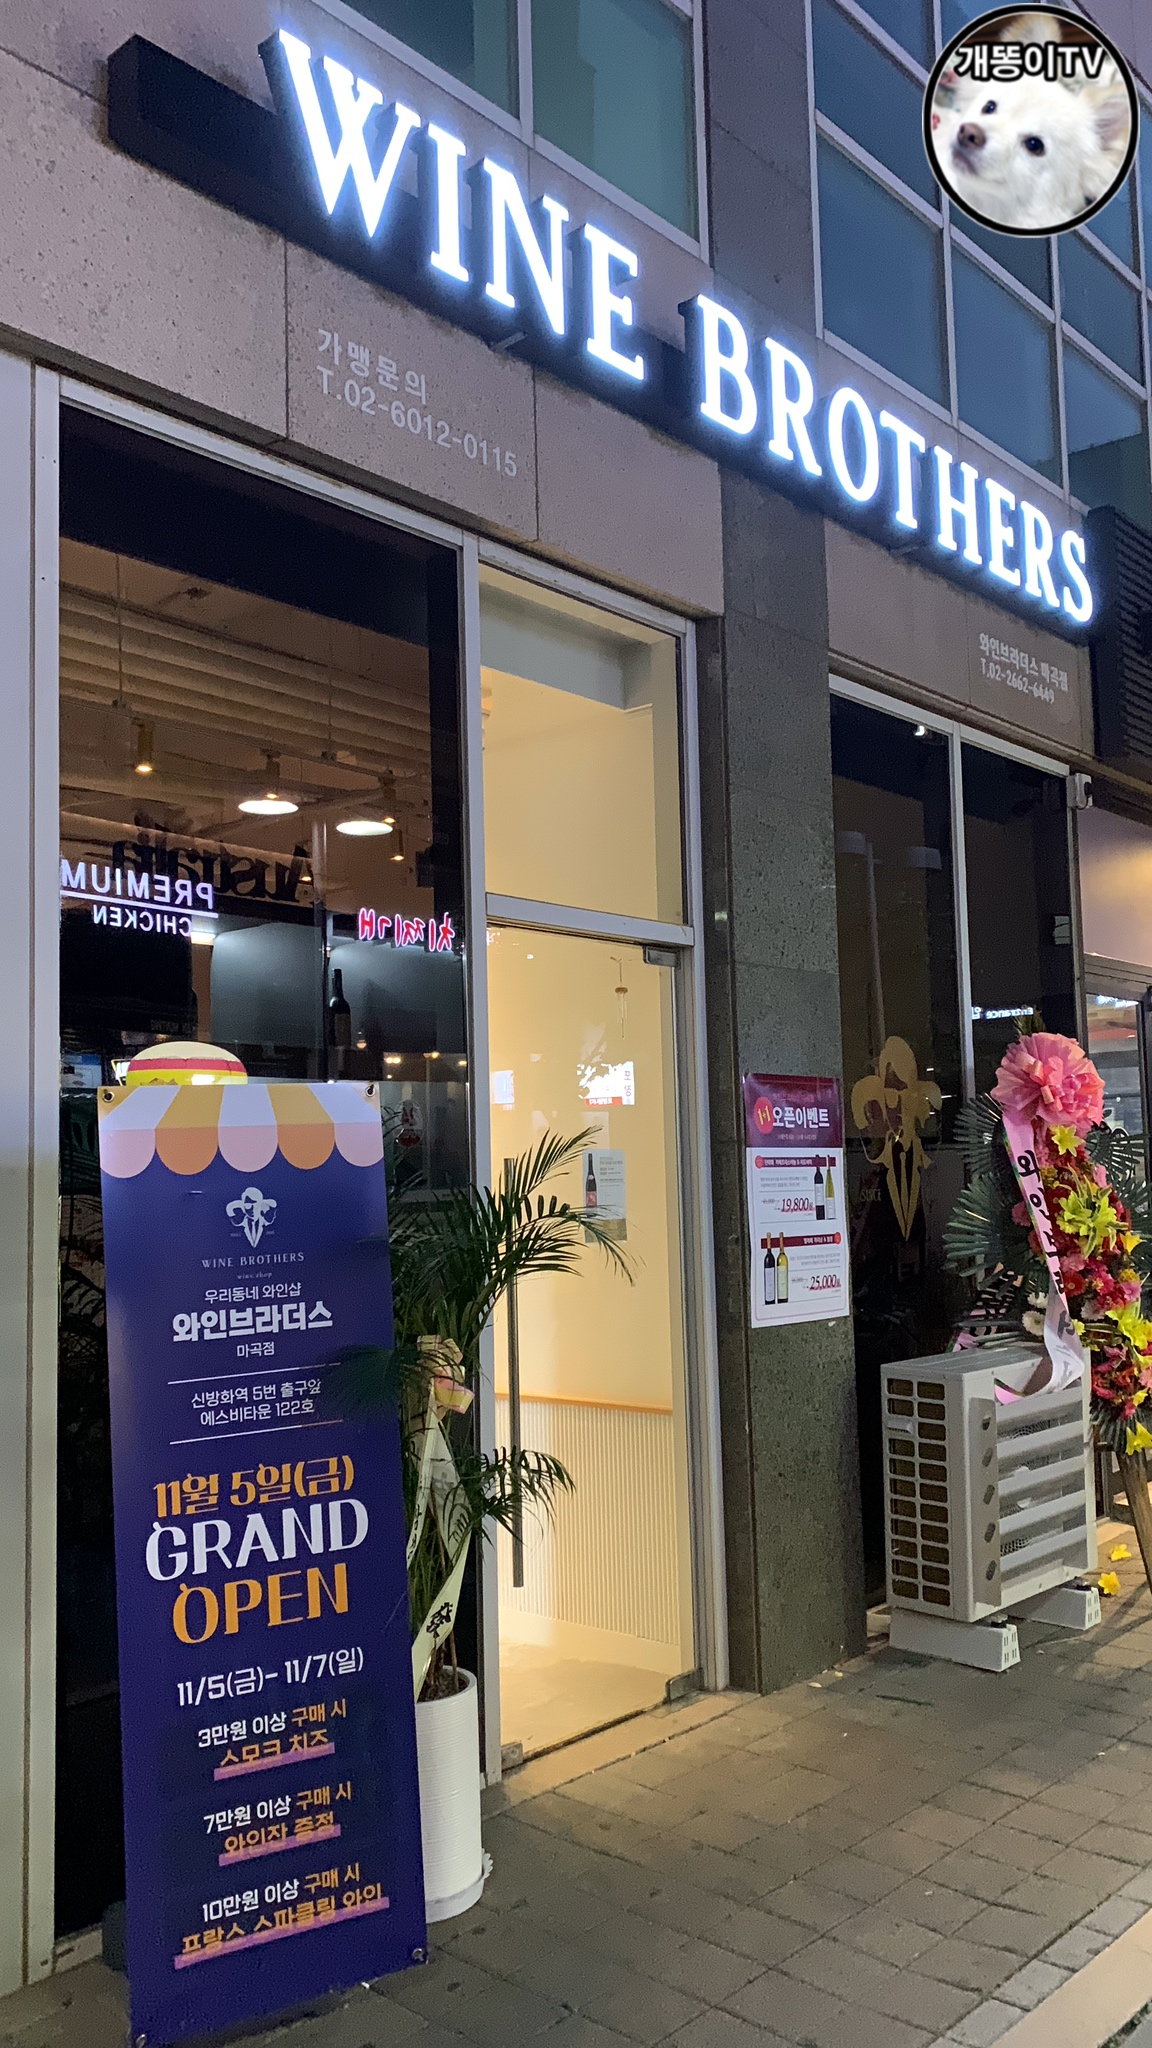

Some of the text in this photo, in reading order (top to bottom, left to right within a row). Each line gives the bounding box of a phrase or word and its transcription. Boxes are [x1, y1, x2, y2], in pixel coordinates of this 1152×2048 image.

[278, 28, 1094, 623] WINE BROTHERS
[316, 365, 518, 477] T.02-6012-0115
[980, 632, 1069, 693] 와인브라더스 마곡점
[773, 1106, 830, 1129] 오픈이벤트
[202, 1252, 305, 1269] WINE BROTHERS
[204, 1282, 302, 1305] 우리동네 와인샵
[172, 1300, 333, 1343] 와인브라더스
[236, 1341, 275, 1358] 마곡점
[191, 1378, 321, 1409] 신방화역 5번 출구앞
[200, 1398, 315, 1427] 에스비타운 122호
[153, 1455, 355, 1519] 11월 5일(금)
[145, 1498, 369, 1581] GRAND
[172, 1562, 349, 1644] OPEN
[198, 1698, 347, 1748] 3만원 이상 구매 시
[219, 1728, 332, 1774] 스모크 치즈
[203, 1781, 352, 1834] 7만원 이상 구매 시
[224, 1811, 335, 1857] 와인잔 증정
[202, 1862, 360, 1922] 10만원 이상 구매 시
[182, 1882, 383, 1956] 프랑스 스파클링 와인
